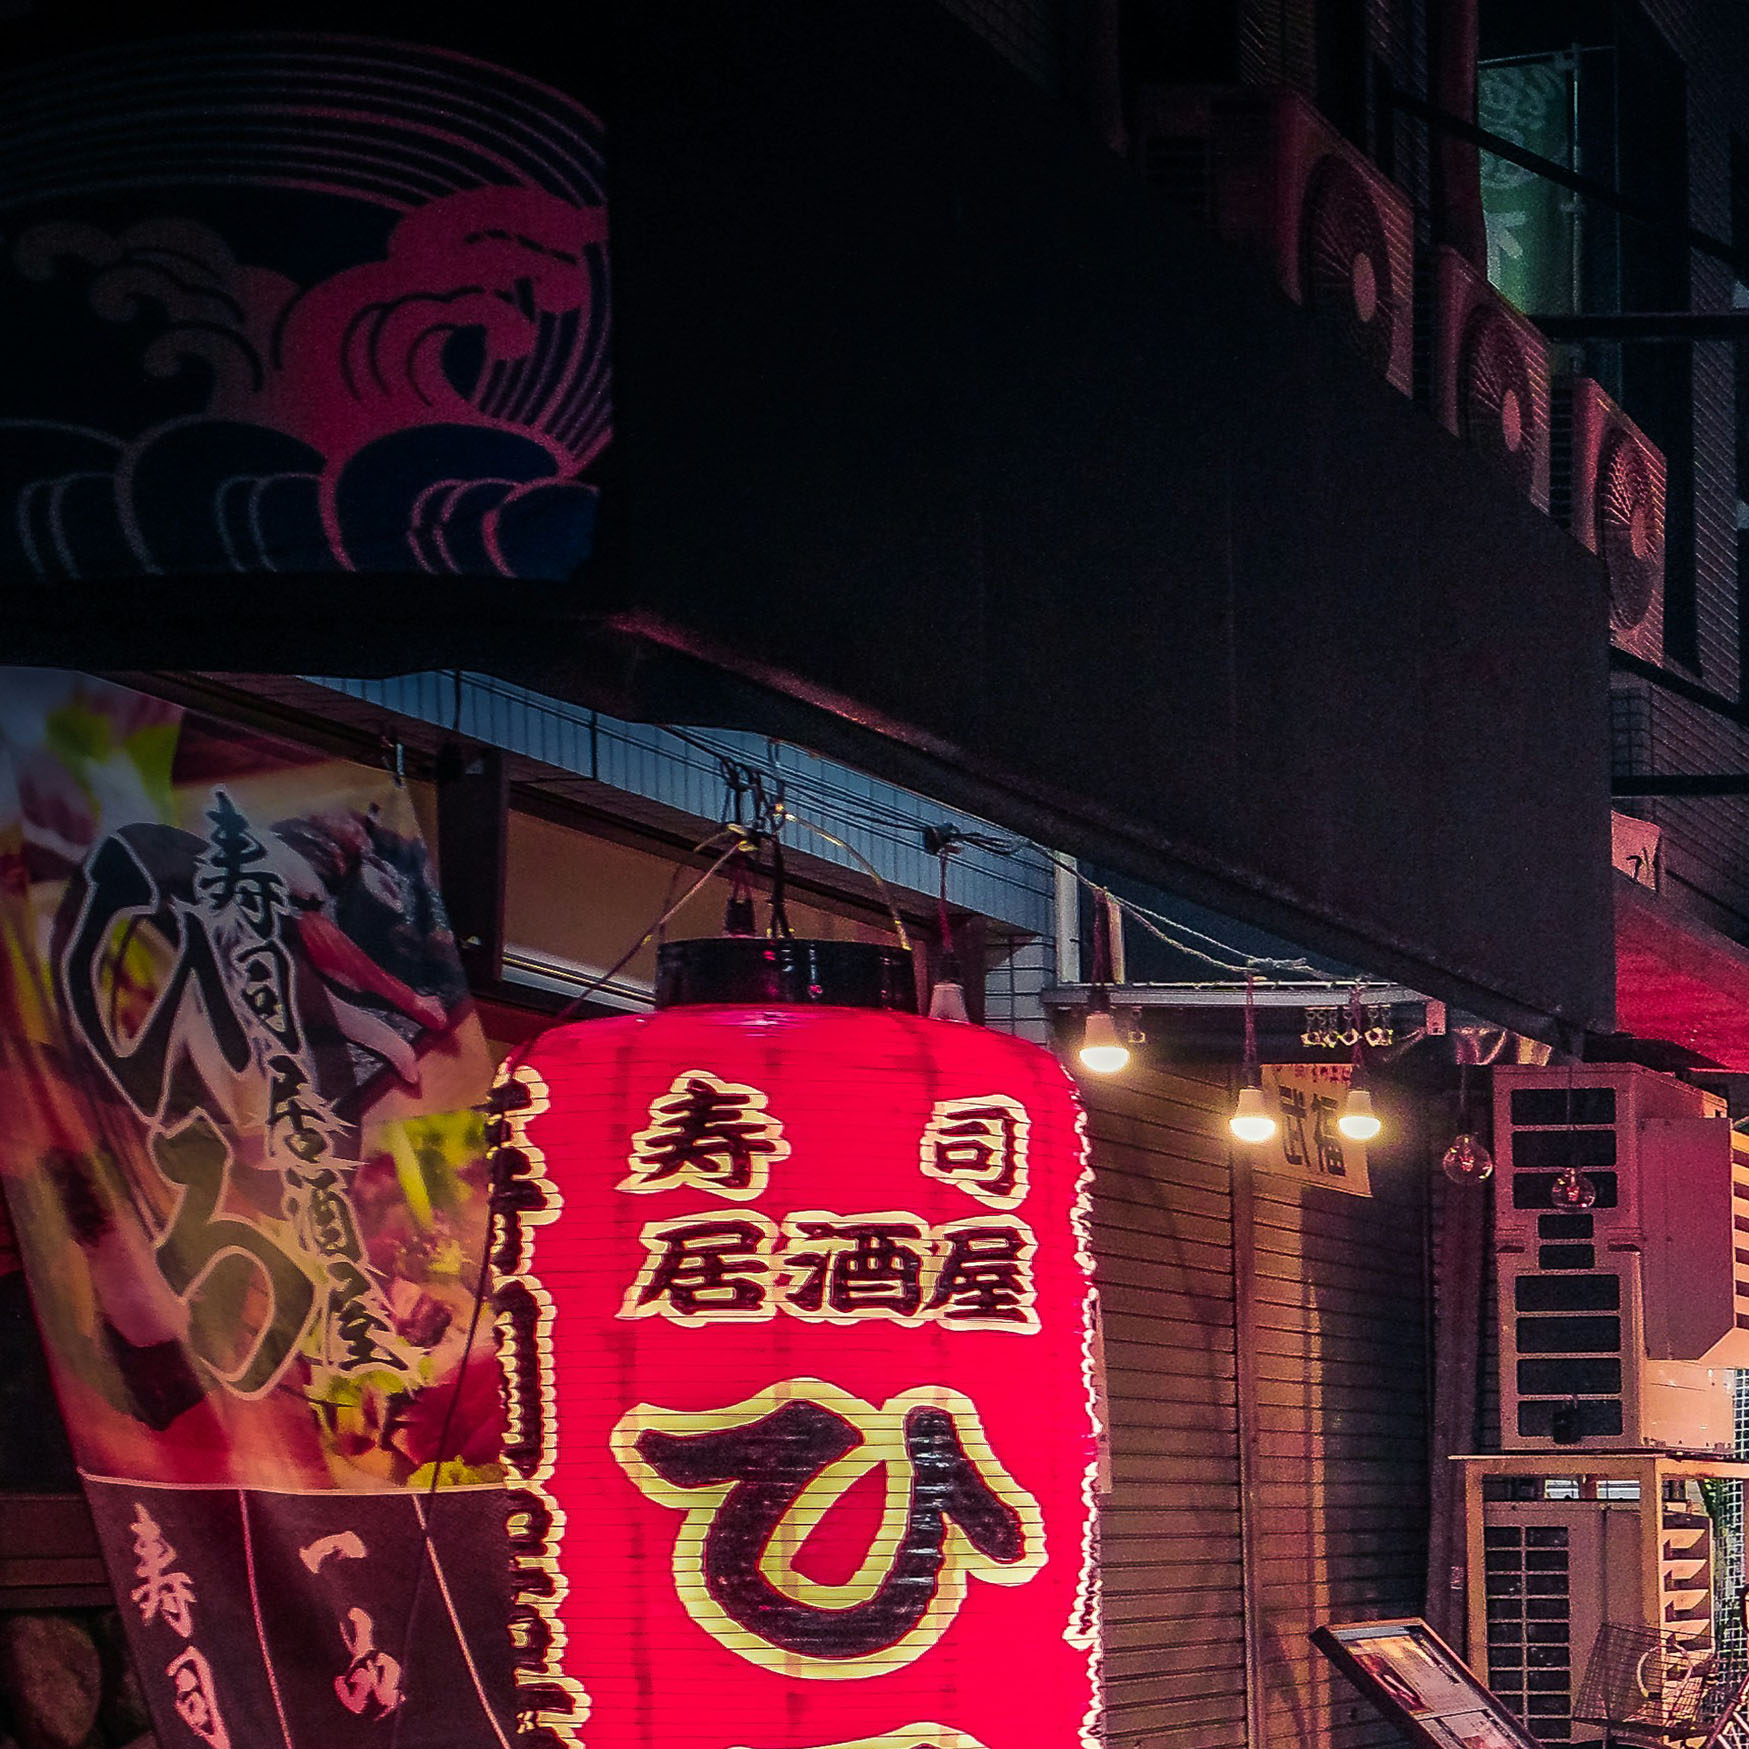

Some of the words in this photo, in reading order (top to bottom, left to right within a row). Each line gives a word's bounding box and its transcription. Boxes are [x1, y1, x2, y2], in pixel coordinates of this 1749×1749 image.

[197, 787, 410, 1373] 寿司居酒屋
[628, 1075, 1030, 1205] 寿司
[625, 1218, 1037, 1328] 居酒屋
[300, 1530, 404, 1723] 一品
